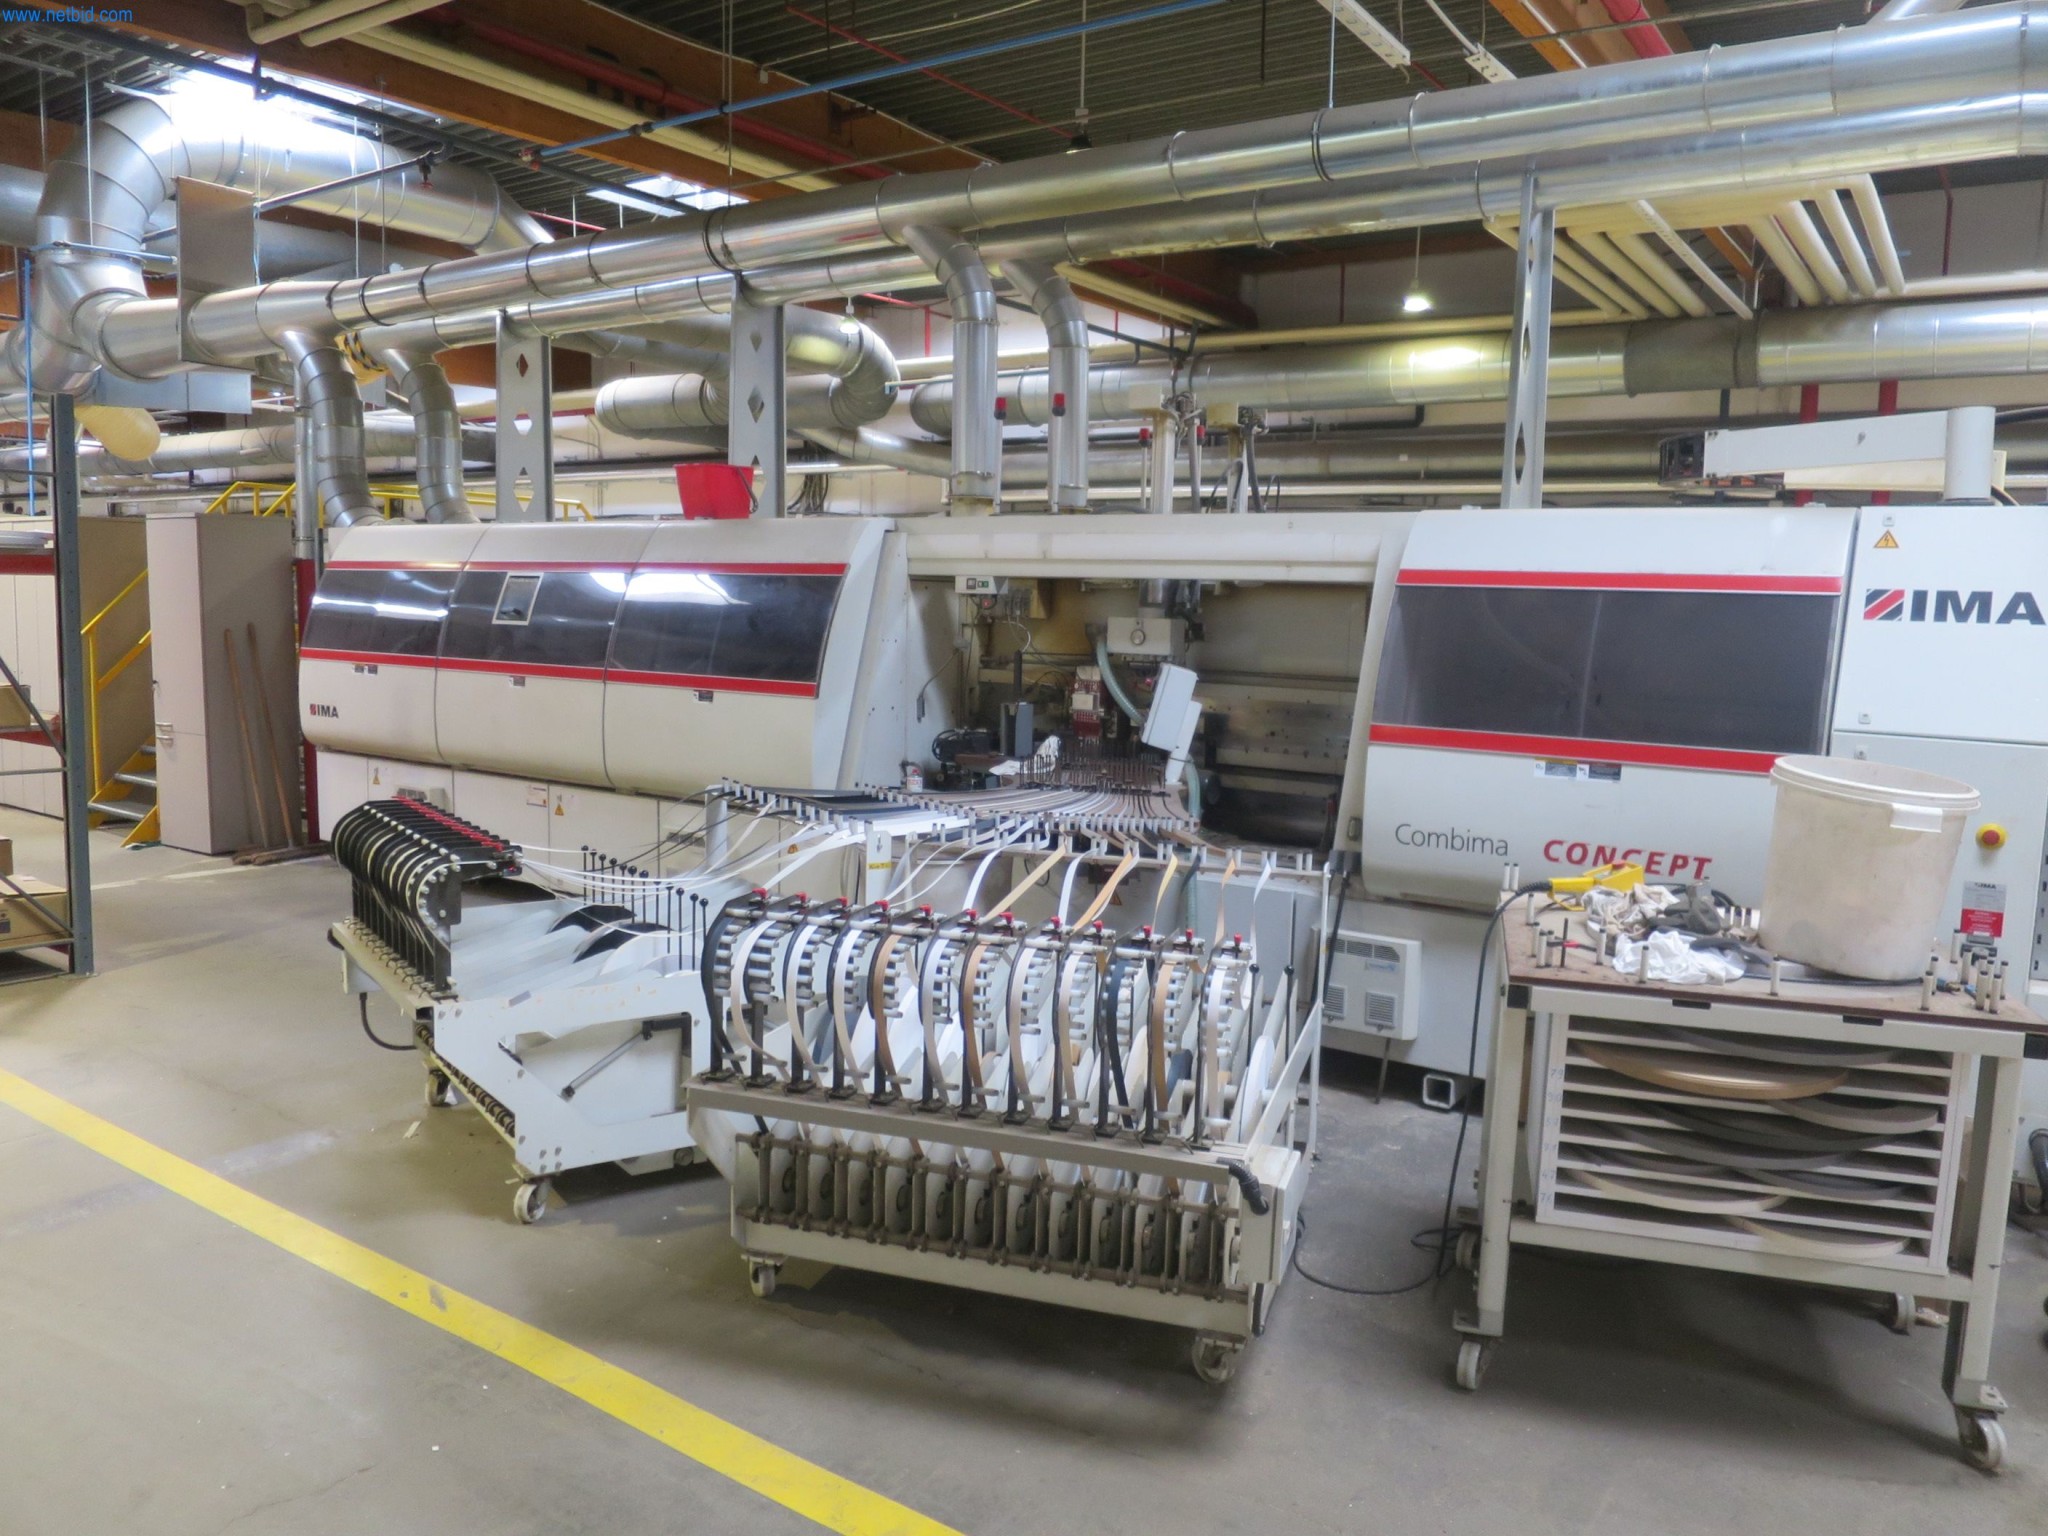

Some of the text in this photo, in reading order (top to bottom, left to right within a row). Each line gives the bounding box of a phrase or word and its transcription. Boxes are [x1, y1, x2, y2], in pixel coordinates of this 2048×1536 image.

[1910, 589, 2047, 625] IMA
[317, 704, 339, 719] IMA
[1395, 823, 1713, 880] Combima CONCEPT
